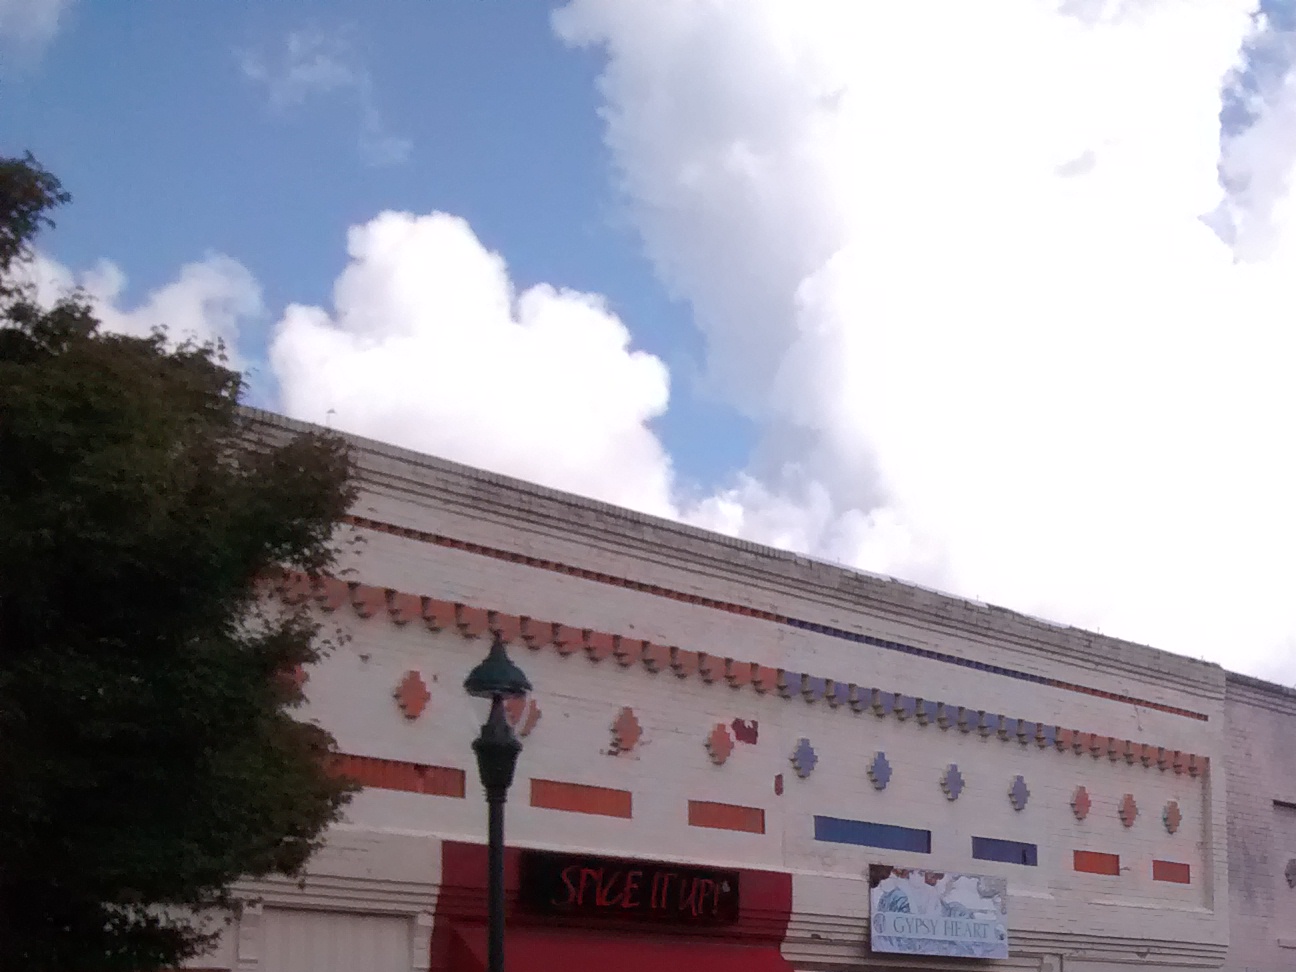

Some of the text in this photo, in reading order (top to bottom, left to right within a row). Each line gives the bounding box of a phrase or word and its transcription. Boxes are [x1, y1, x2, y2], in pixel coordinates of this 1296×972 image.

[550, 866, 642, 908] SPICE
[651, 872, 676, 908] IT
[893, 917, 989, 939] GYPSY HEART
